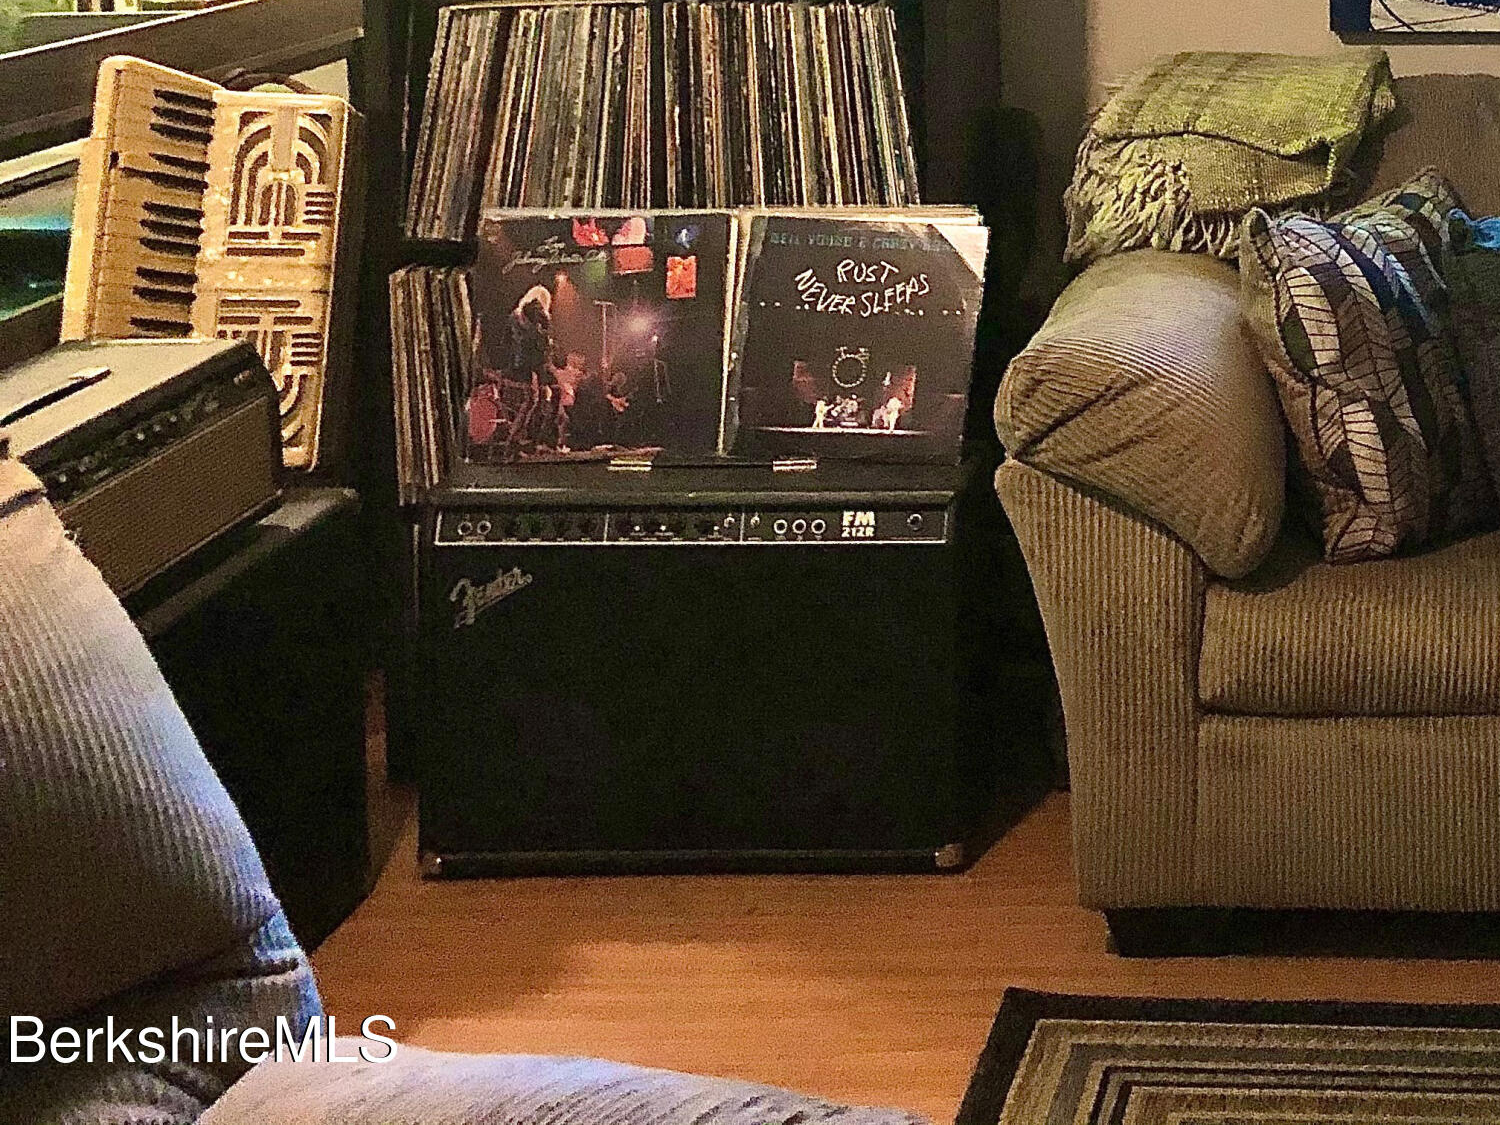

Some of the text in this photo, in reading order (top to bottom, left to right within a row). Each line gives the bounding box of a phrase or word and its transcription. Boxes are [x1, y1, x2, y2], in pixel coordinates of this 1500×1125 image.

[836, 258, 899, 284] RUST
[794, 268, 931, 317] NEVER SLEEPS
[842, 510, 876, 526] FM
[841, 526, 875, 538] 212R
